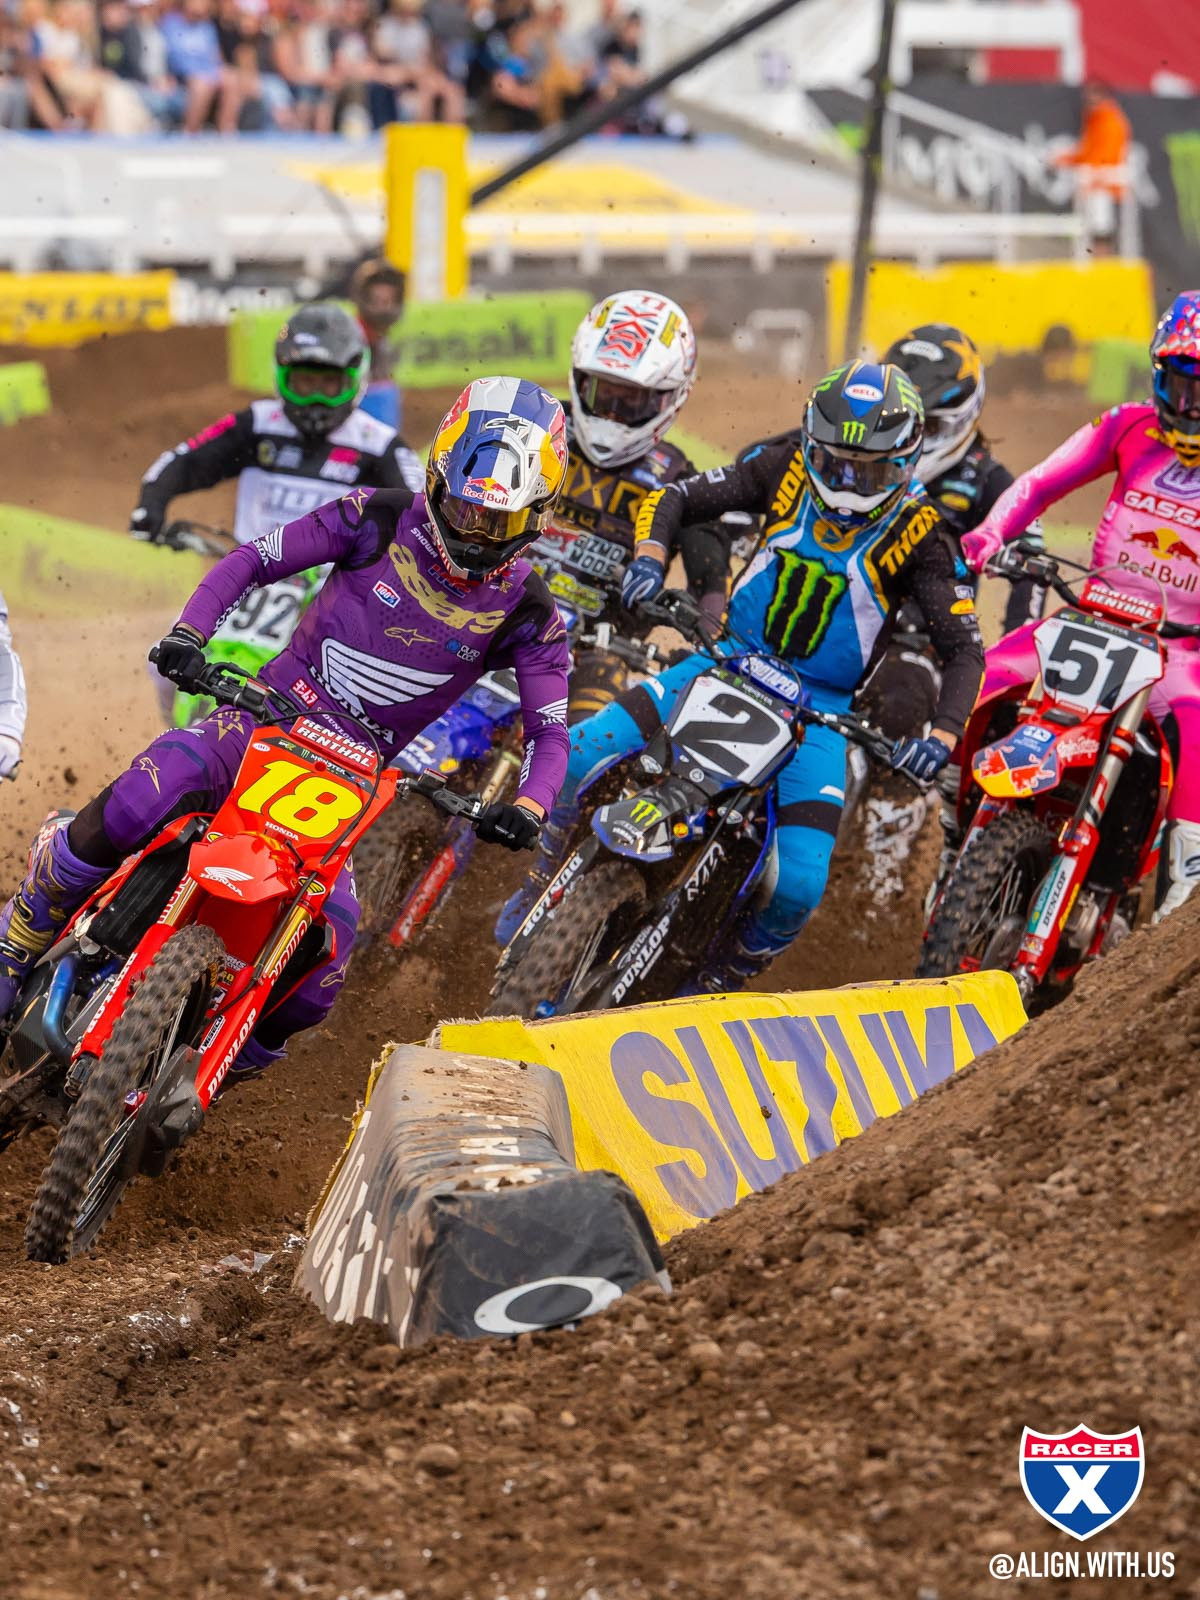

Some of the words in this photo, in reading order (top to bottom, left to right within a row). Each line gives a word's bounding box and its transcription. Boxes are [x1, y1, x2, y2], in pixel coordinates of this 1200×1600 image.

[852, 387, 877, 398] BELL
[463, 486, 487, 501] Red
[486, 493, 509, 507] Bull
[771, 450, 808, 518] HOR
[1124, 490, 1200, 531] GASG
[252, 538, 270, 567] ONDA
[410, 527, 439, 559] SHOWA
[878, 505, 942, 577] THOR
[1117, 551, 1156, 577] Red
[1158, 562, 1198, 593] Bull
[233, 588, 297, 639] 92
[376, 584, 397, 605] 100%
[1085, 593, 1155, 620] RENTHAL
[1044, 624, 1139, 711] 51
[308, 665, 395, 745] HONDA
[296, 726, 373, 768] RENTHAL
[302, 718, 377, 759] RENTHAL
[670, 692, 781, 780] 2
[237, 759, 363, 839] 18
[264, 820, 300, 842] HONDA
[200, 871, 244, 897] HONDA
[1043, 870, 1067, 929] DUNLOP
[611, 914, 672, 1004] DUNLOP
[207, 1007, 258, 1099] DUNLOP
